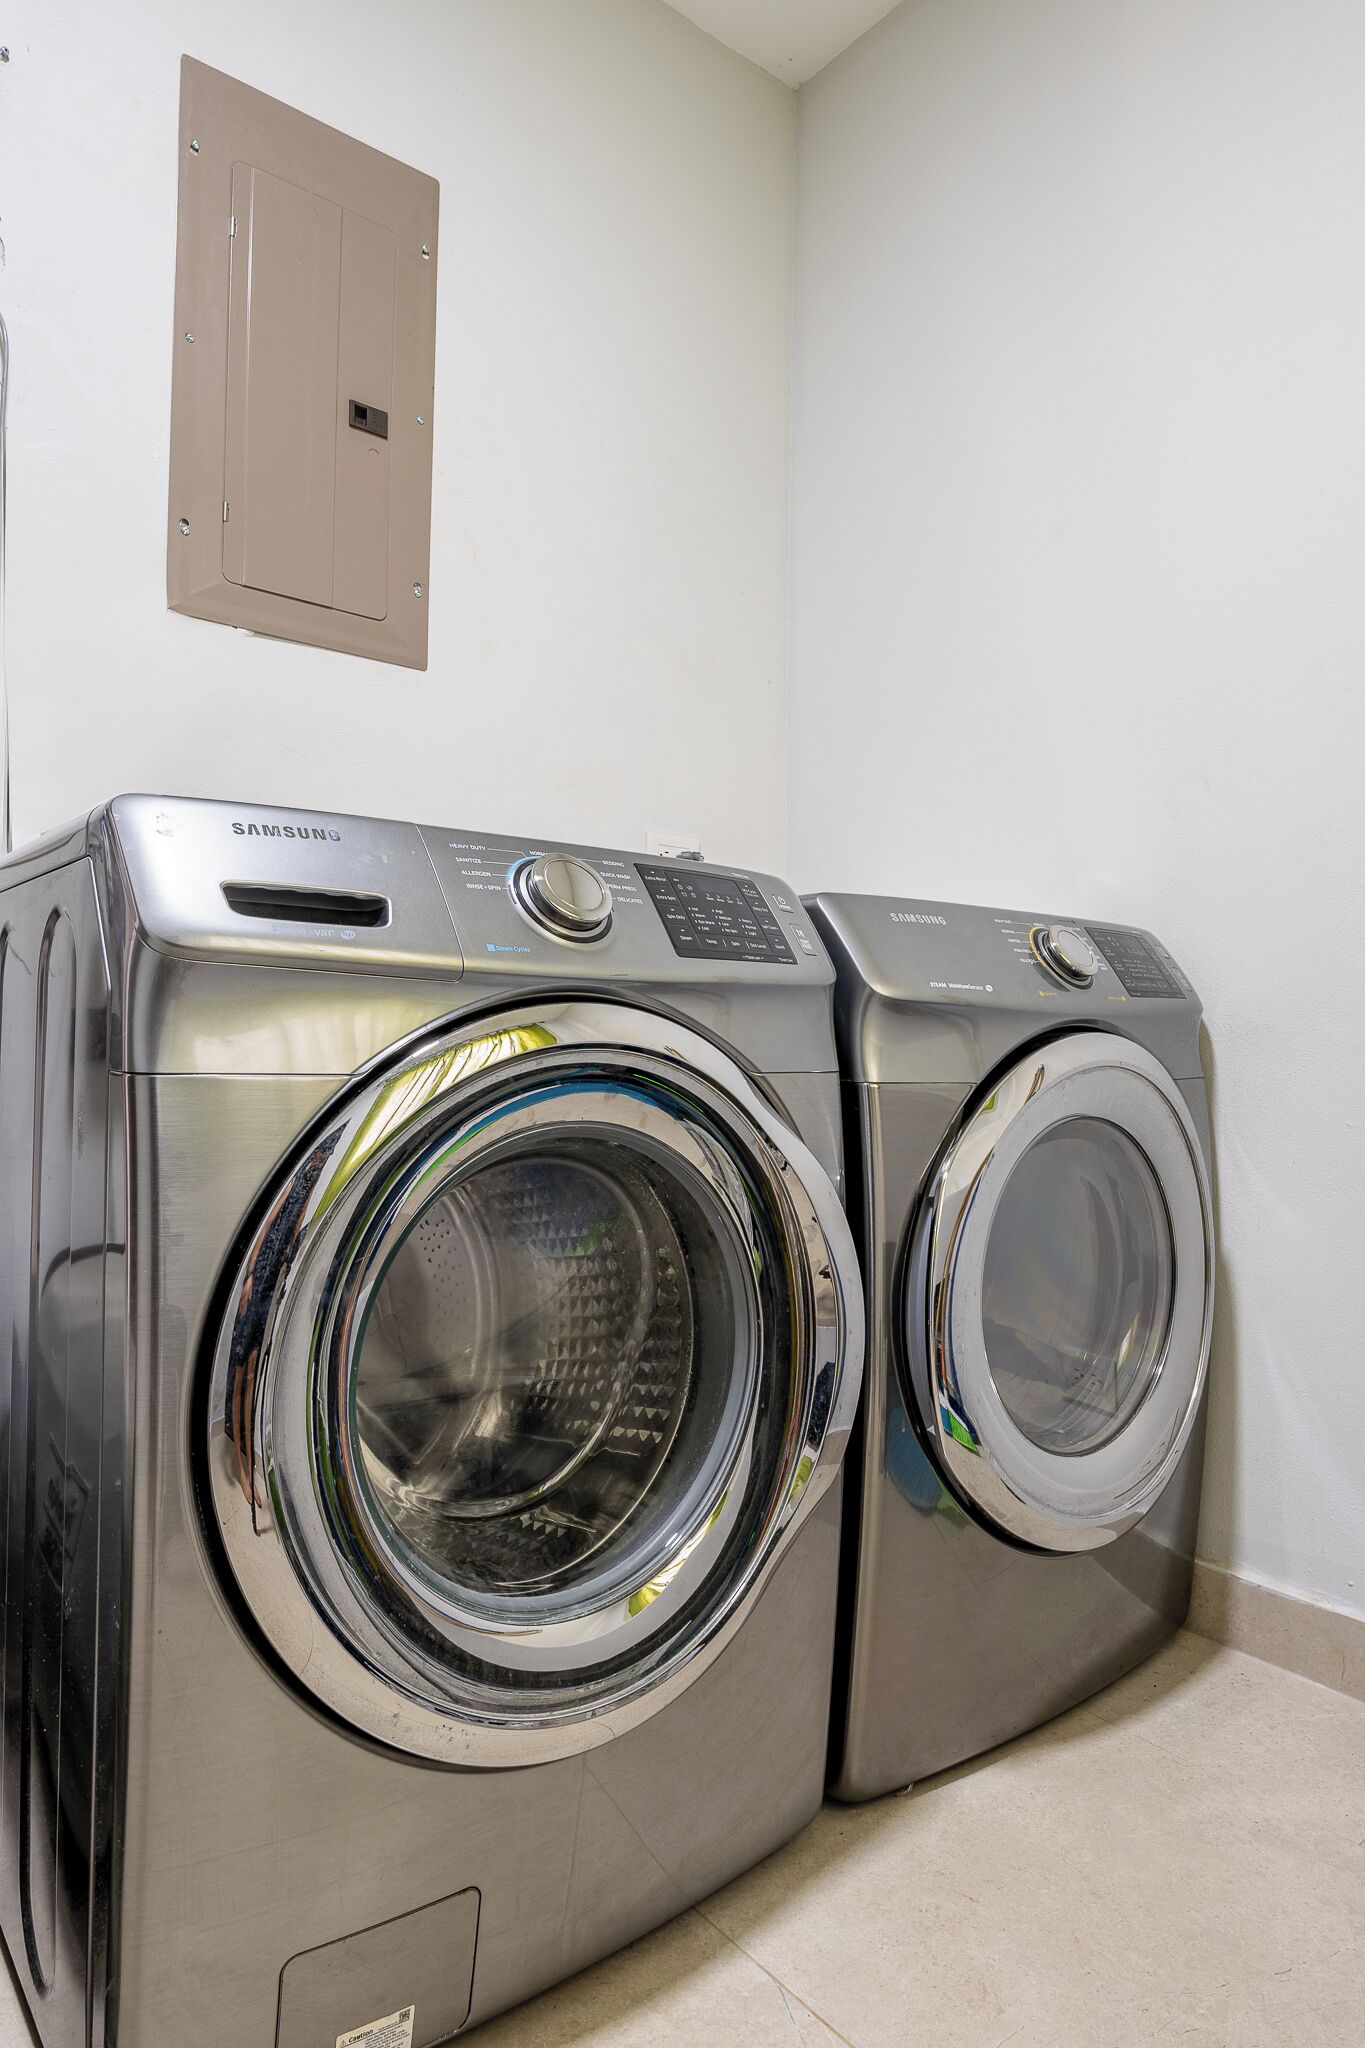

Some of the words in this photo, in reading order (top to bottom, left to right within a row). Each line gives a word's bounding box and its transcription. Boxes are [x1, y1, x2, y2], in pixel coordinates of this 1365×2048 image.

[231, 821, 341, 842] SAMSUNG
[616, 896, 643, 904] DELICATES
[890, 912, 947, 926] SAMSUNG
[348, 2029, 374, 2043] Caution
